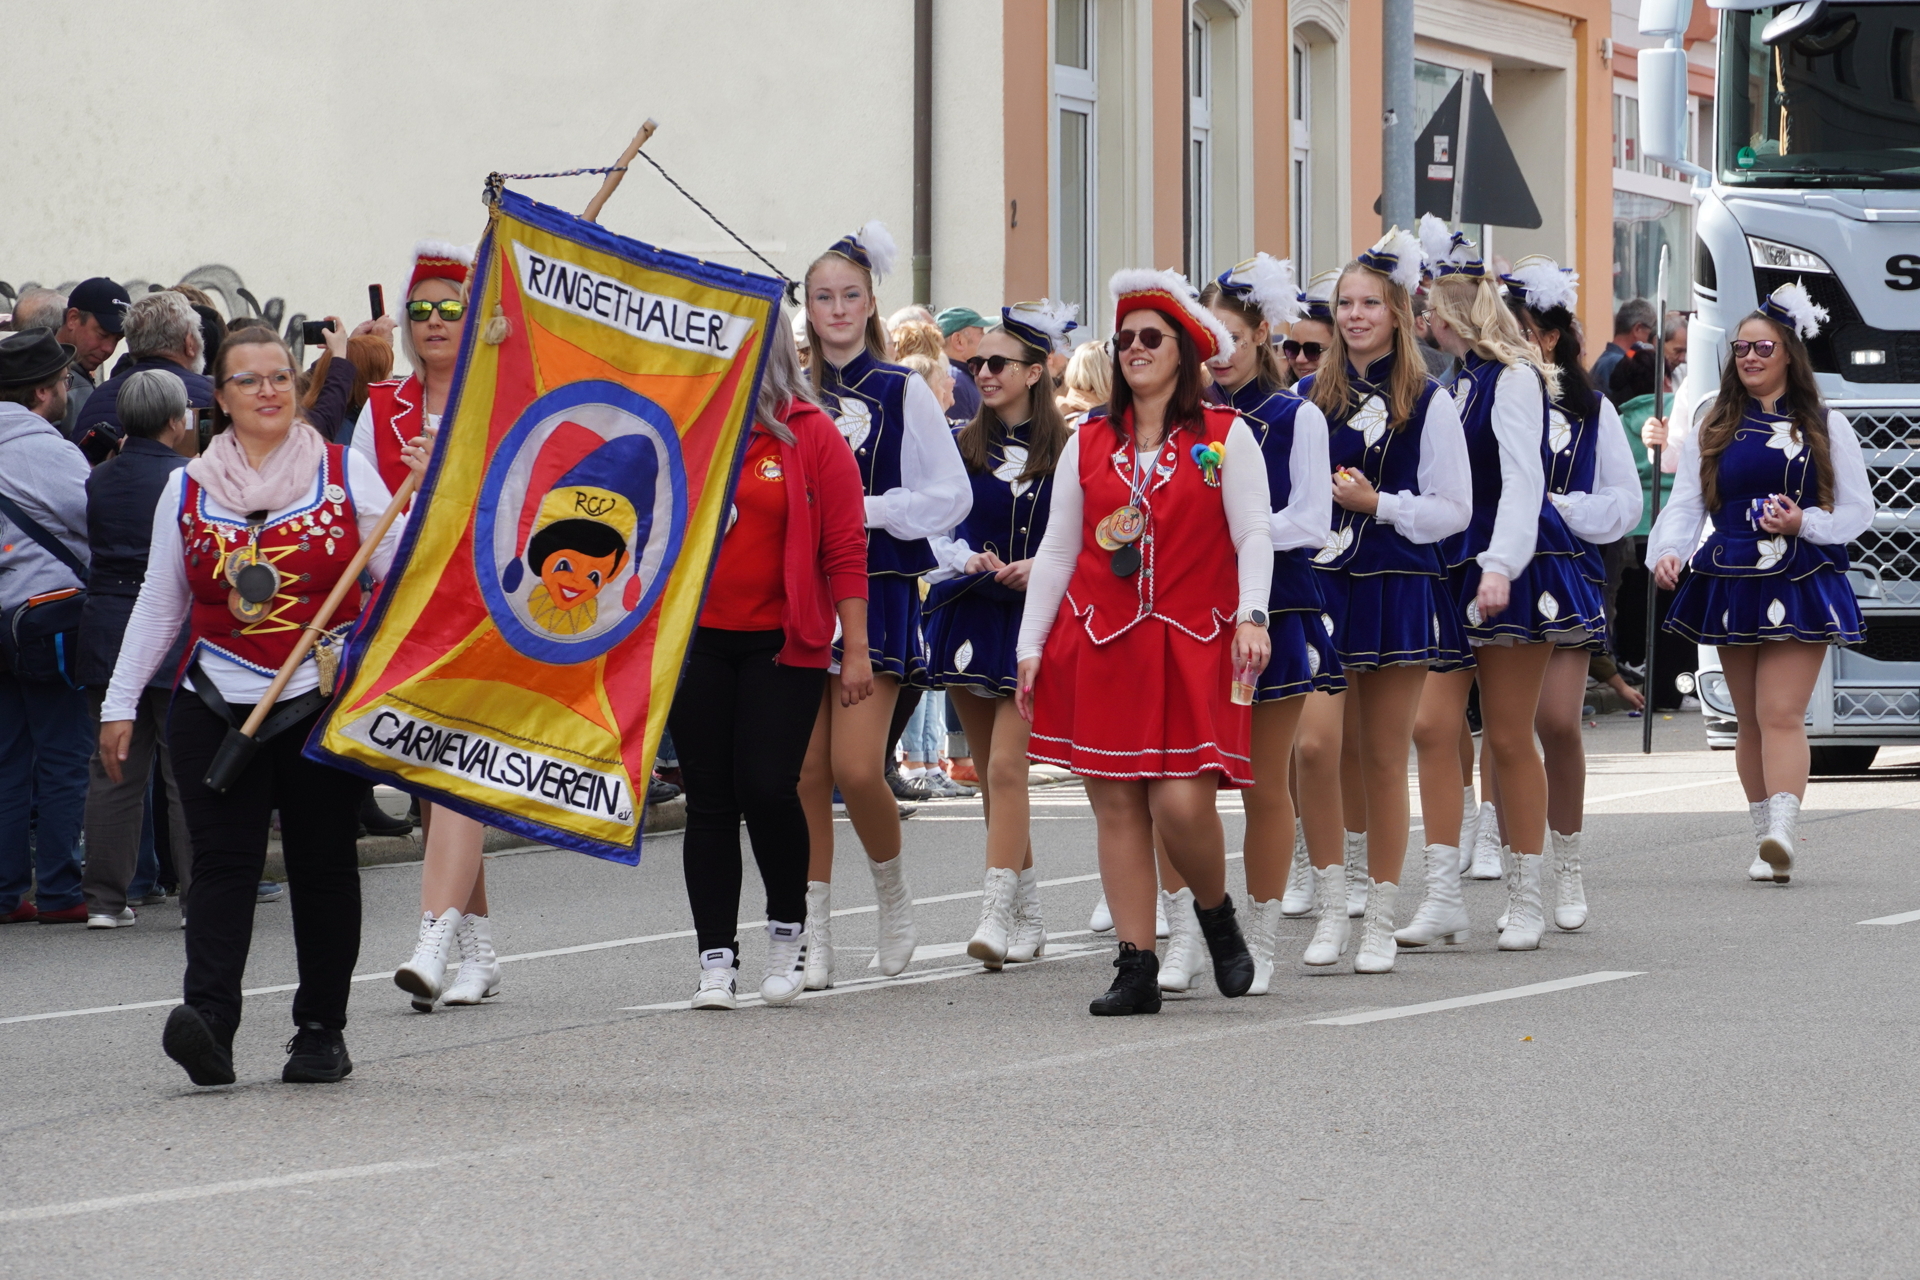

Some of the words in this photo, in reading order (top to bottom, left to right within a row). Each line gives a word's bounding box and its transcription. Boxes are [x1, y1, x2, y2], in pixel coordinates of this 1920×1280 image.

[528, 254, 728, 351] RINGETHALER
[1884, 253, 1920, 291] S
[368, 711, 621, 815] CARNEVALSVEREIN
